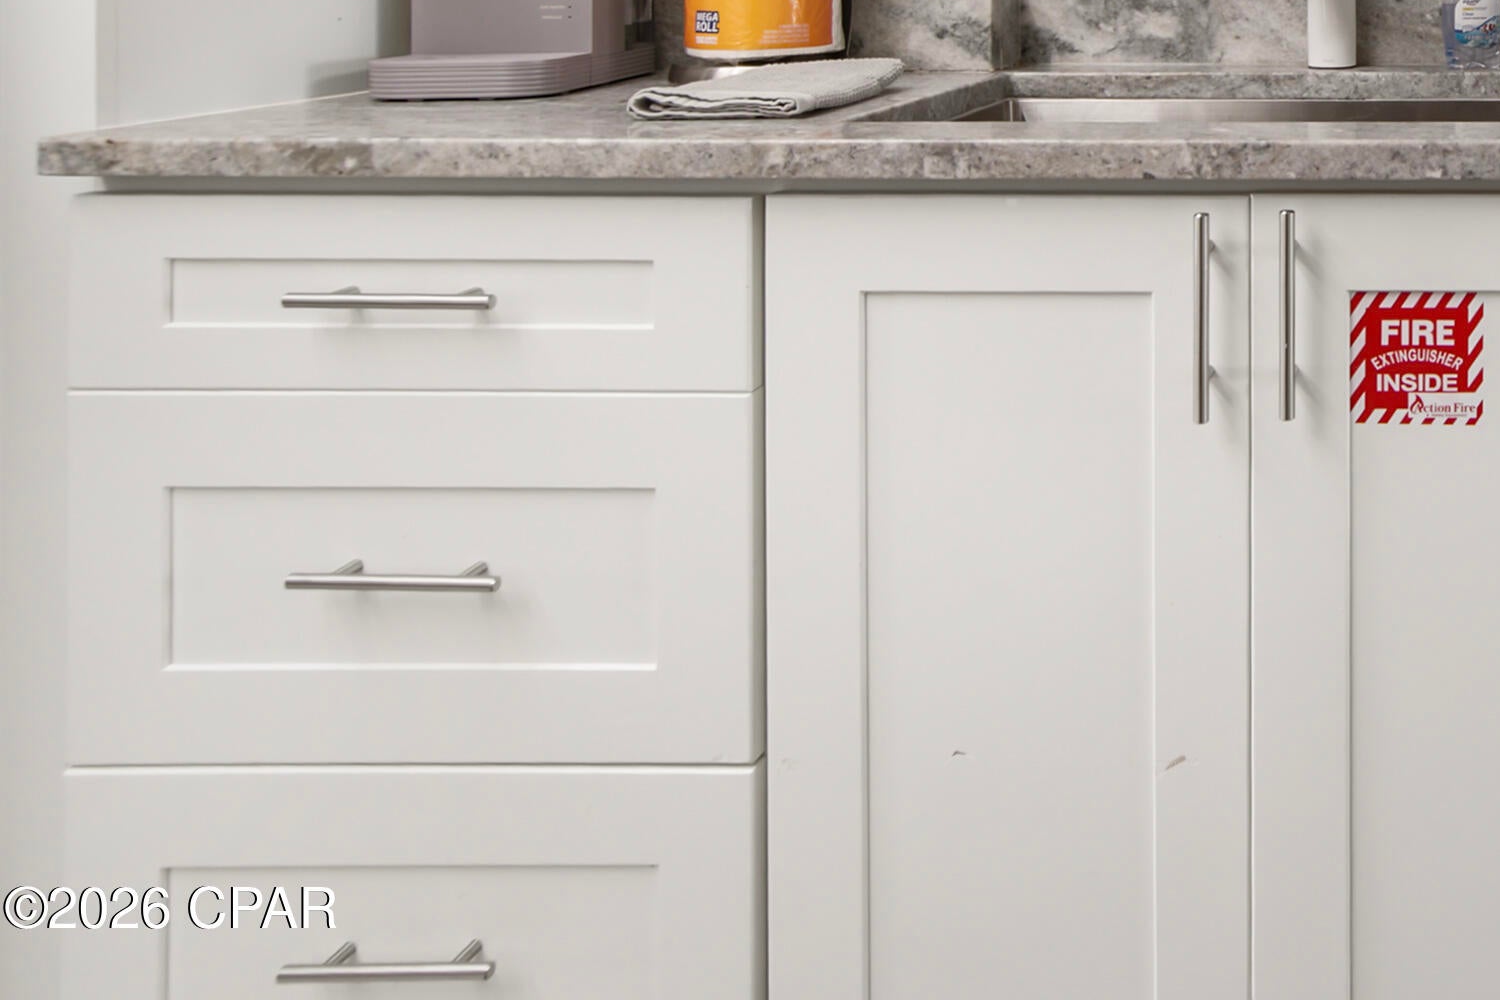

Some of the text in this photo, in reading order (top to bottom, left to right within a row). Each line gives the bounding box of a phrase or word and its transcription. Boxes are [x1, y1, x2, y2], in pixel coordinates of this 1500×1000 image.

[695, 21, 719, 32] ROLL
[1380, 319, 1455, 346] FIRE
[1370, 348, 1464, 371] EXTINGUISHER
[1376, 373, 1458, 392] INSIDE
[1453, 403, 1476, 412] Fire
